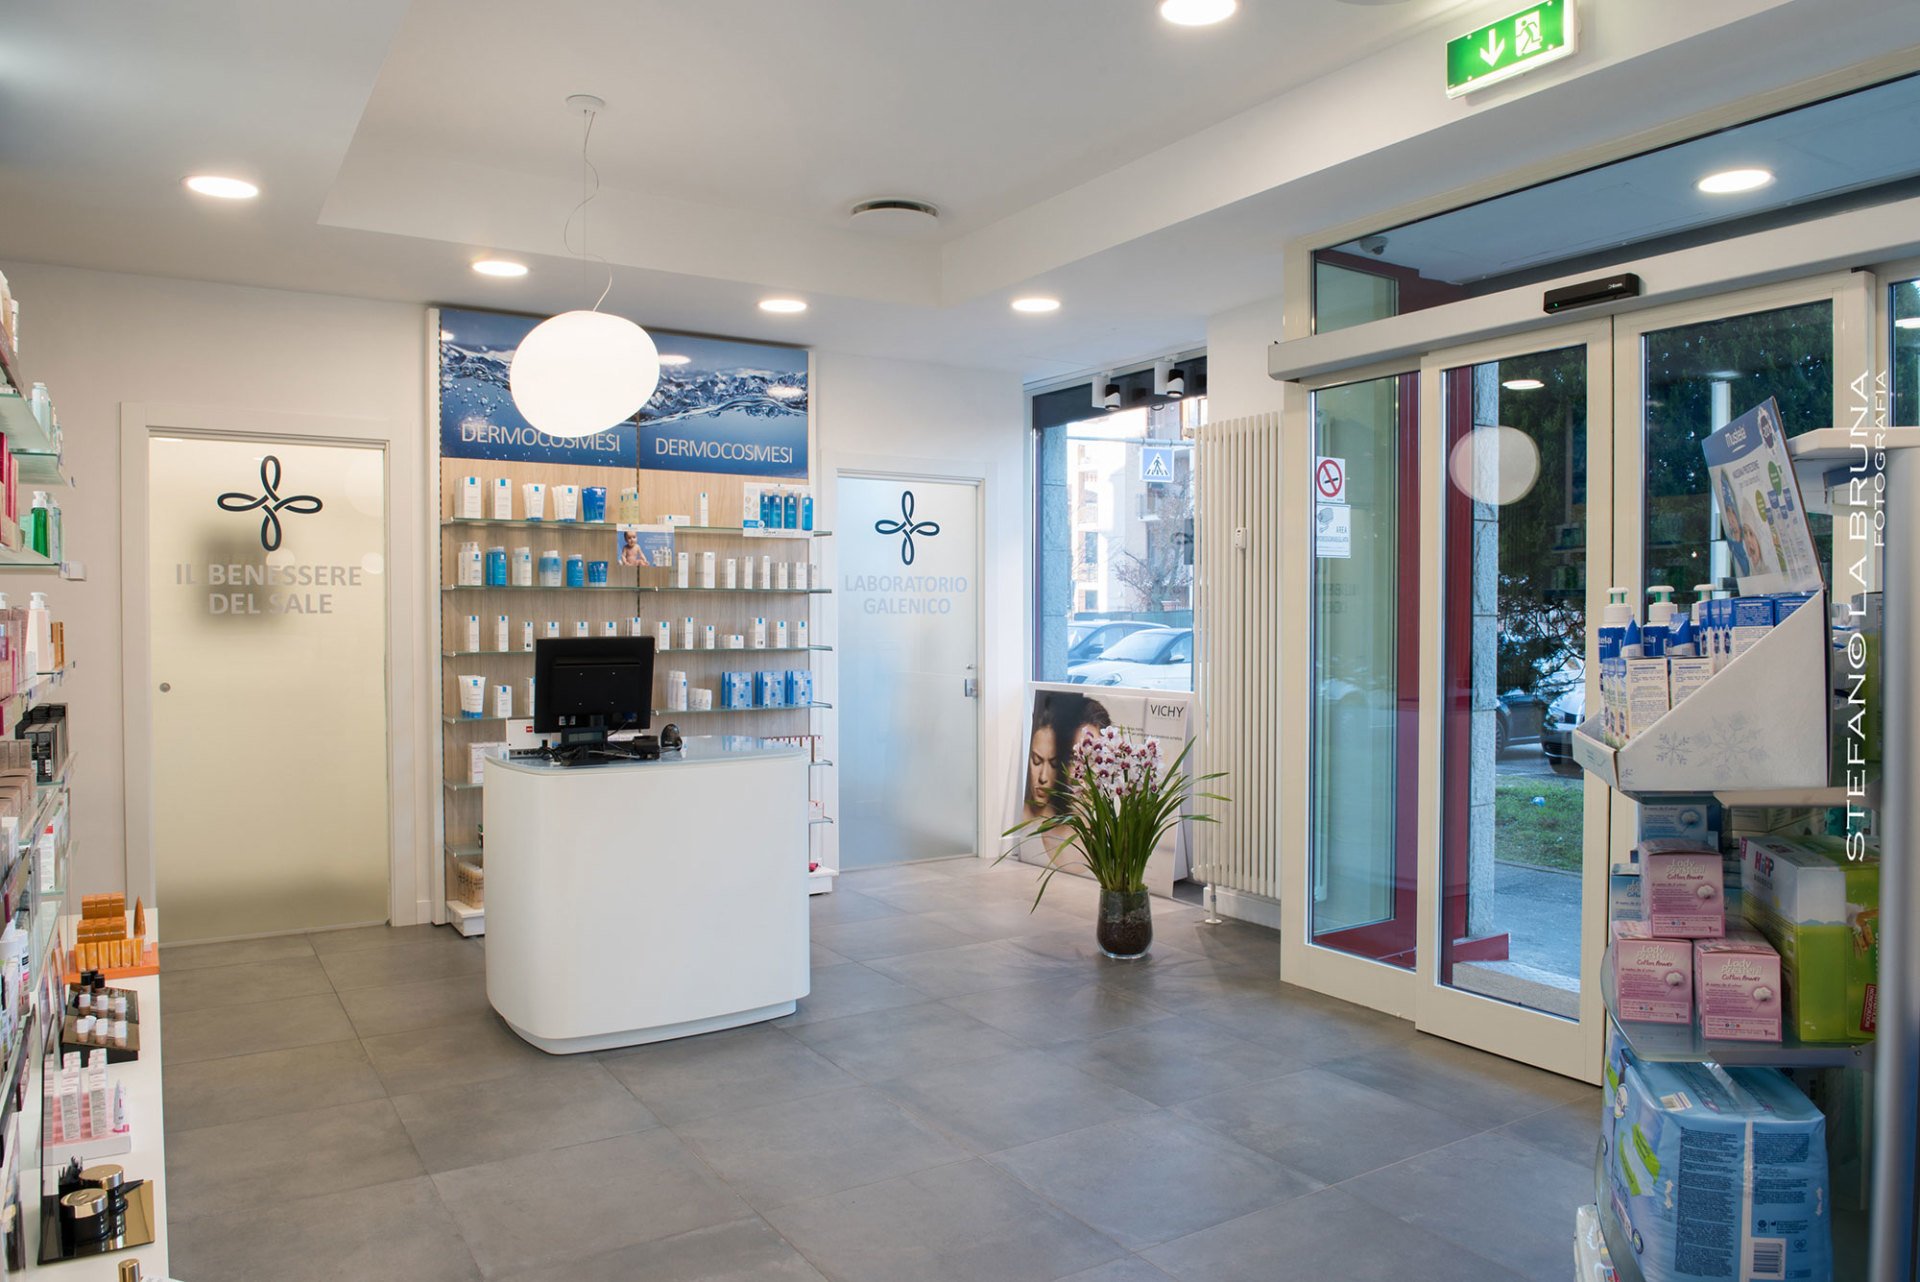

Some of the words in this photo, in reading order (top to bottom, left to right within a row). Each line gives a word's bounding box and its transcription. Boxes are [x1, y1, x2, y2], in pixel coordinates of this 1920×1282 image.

[461, 423, 620, 452] DERMOCOSMESI
[655, 436, 794, 464] DERMOCOSMESI
[176, 563, 195, 585] IL
[208, 565, 362, 586] BENESSERE
[845, 575, 967, 593] LABORATORIO
[209, 593, 261, 615] DEL
[269, 594, 333, 615] SALE
[863, 598, 951, 615] GALENICO
[1150, 704, 1185, 718] VICHY
